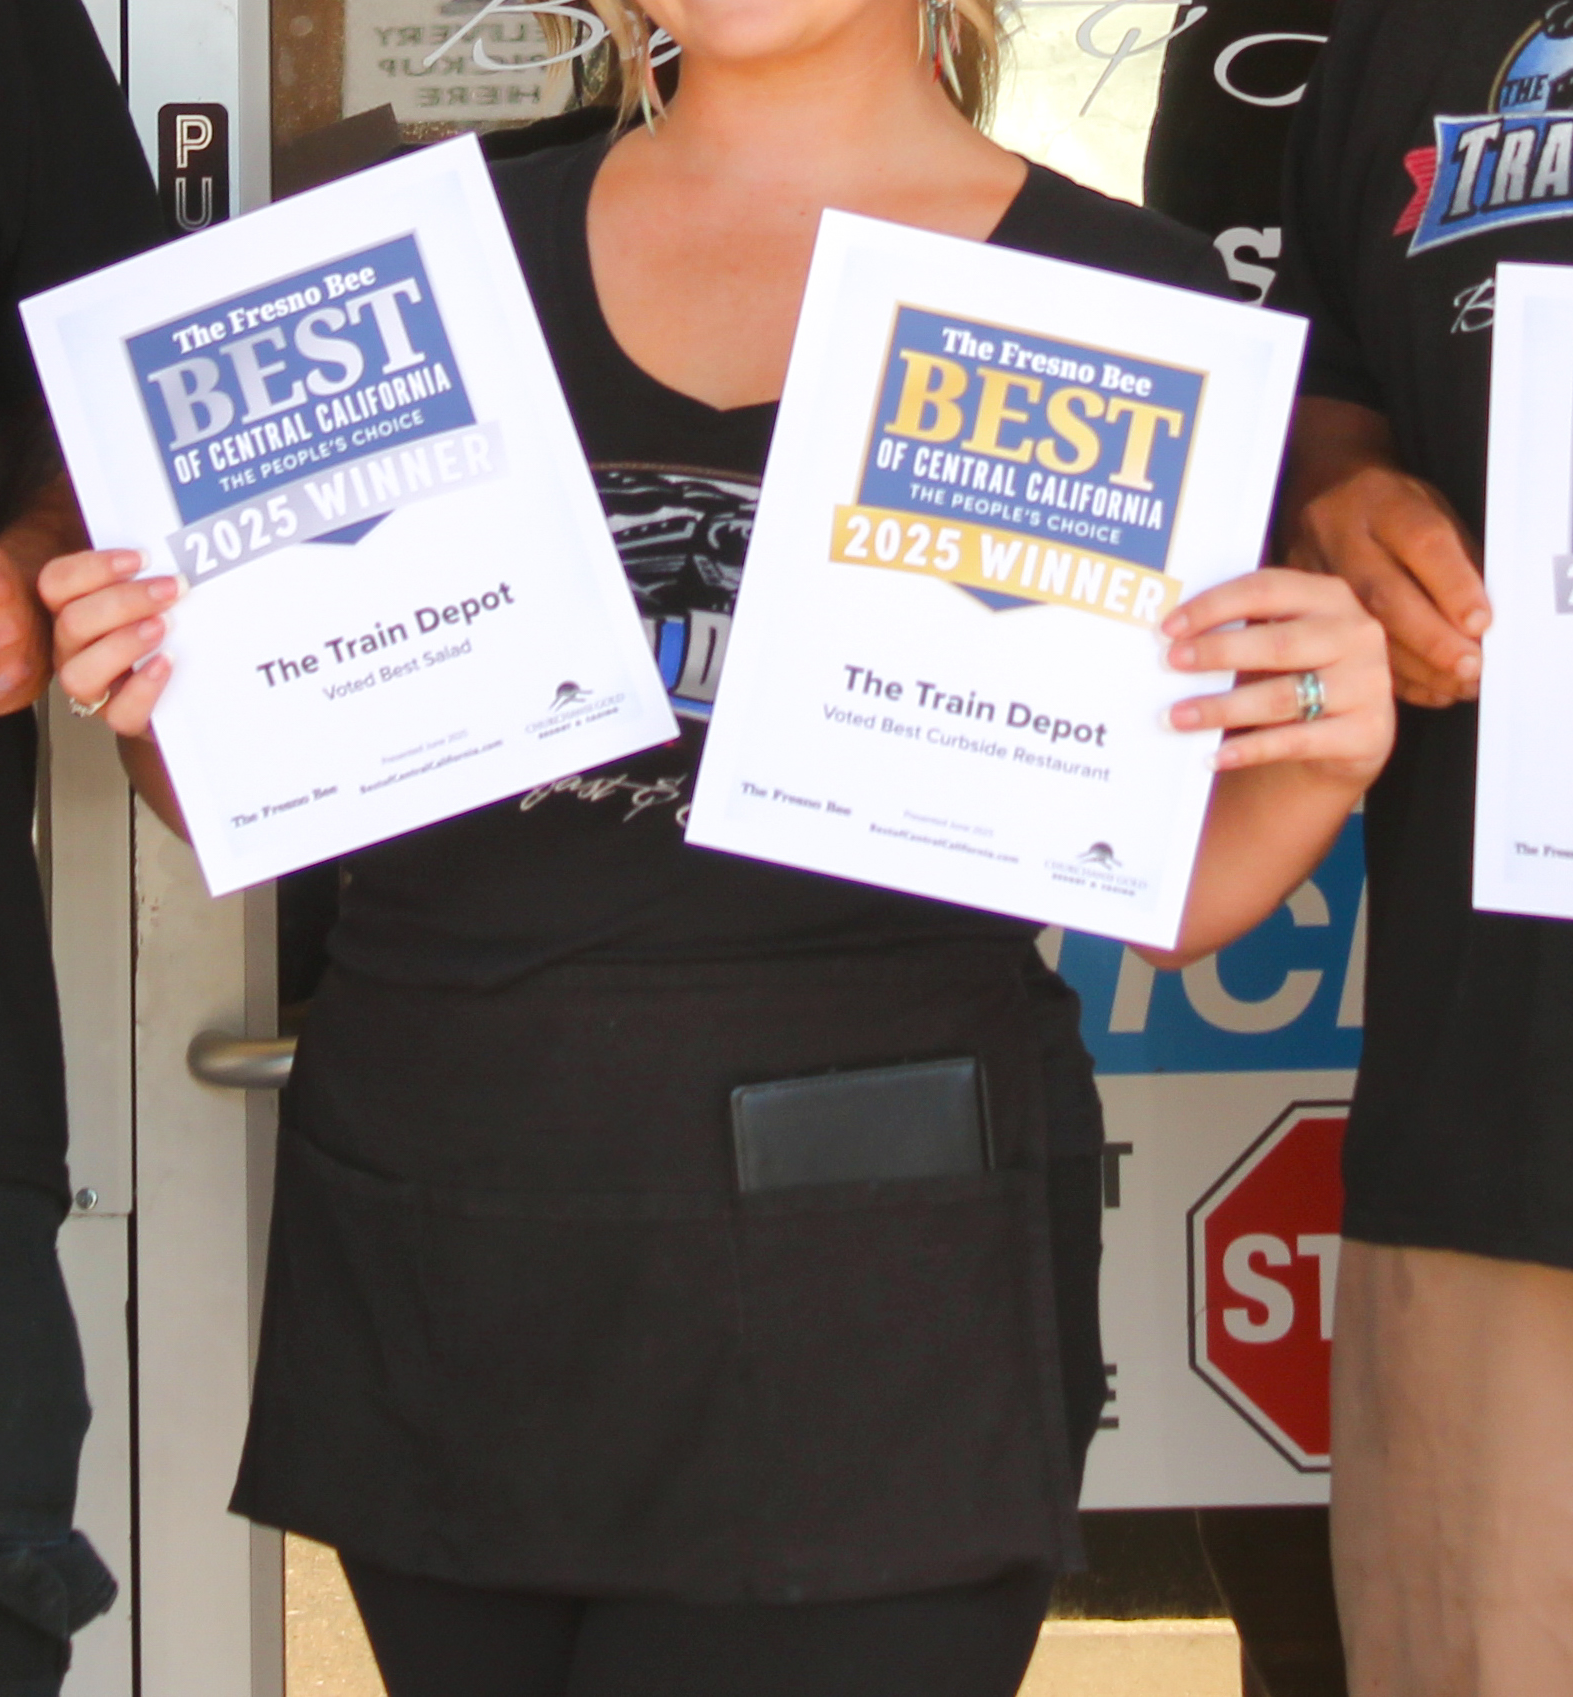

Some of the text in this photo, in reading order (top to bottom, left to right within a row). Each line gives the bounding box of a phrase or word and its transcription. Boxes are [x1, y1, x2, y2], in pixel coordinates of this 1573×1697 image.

[1501, 73, 1549, 107] THE
[174, 114, 214, 232] PU
[173, 265, 377, 354] The Fresno Bee
[146, 276, 426, 452] BEST
[942, 326, 1153, 398] The Fresno Bee
[173, 362, 452, 485] OF CENTRAL CALIFORNIA
[219, 409, 425, 493] THE PEOPLE'S CHOICE
[883, 348, 1184, 493] BEST
[184, 433, 494, 576] 2025 WINNER
[876, 438, 1164, 531] OF CENTRAL CALIFORNIA
[910, 483, 1124, 545] THE PEOPLE'S CHOICE
[843, 514, 1166, 625] 2025 WINNER
[256, 581, 516, 689] The Train Depot
[322, 638, 474, 701] Voted Best Salad
[823, 703, 1111, 783] Voted Best Curbside Restaurant
[843, 663, 1108, 748] The Train Depot
[1222, 1233, 1341, 1345] ST
